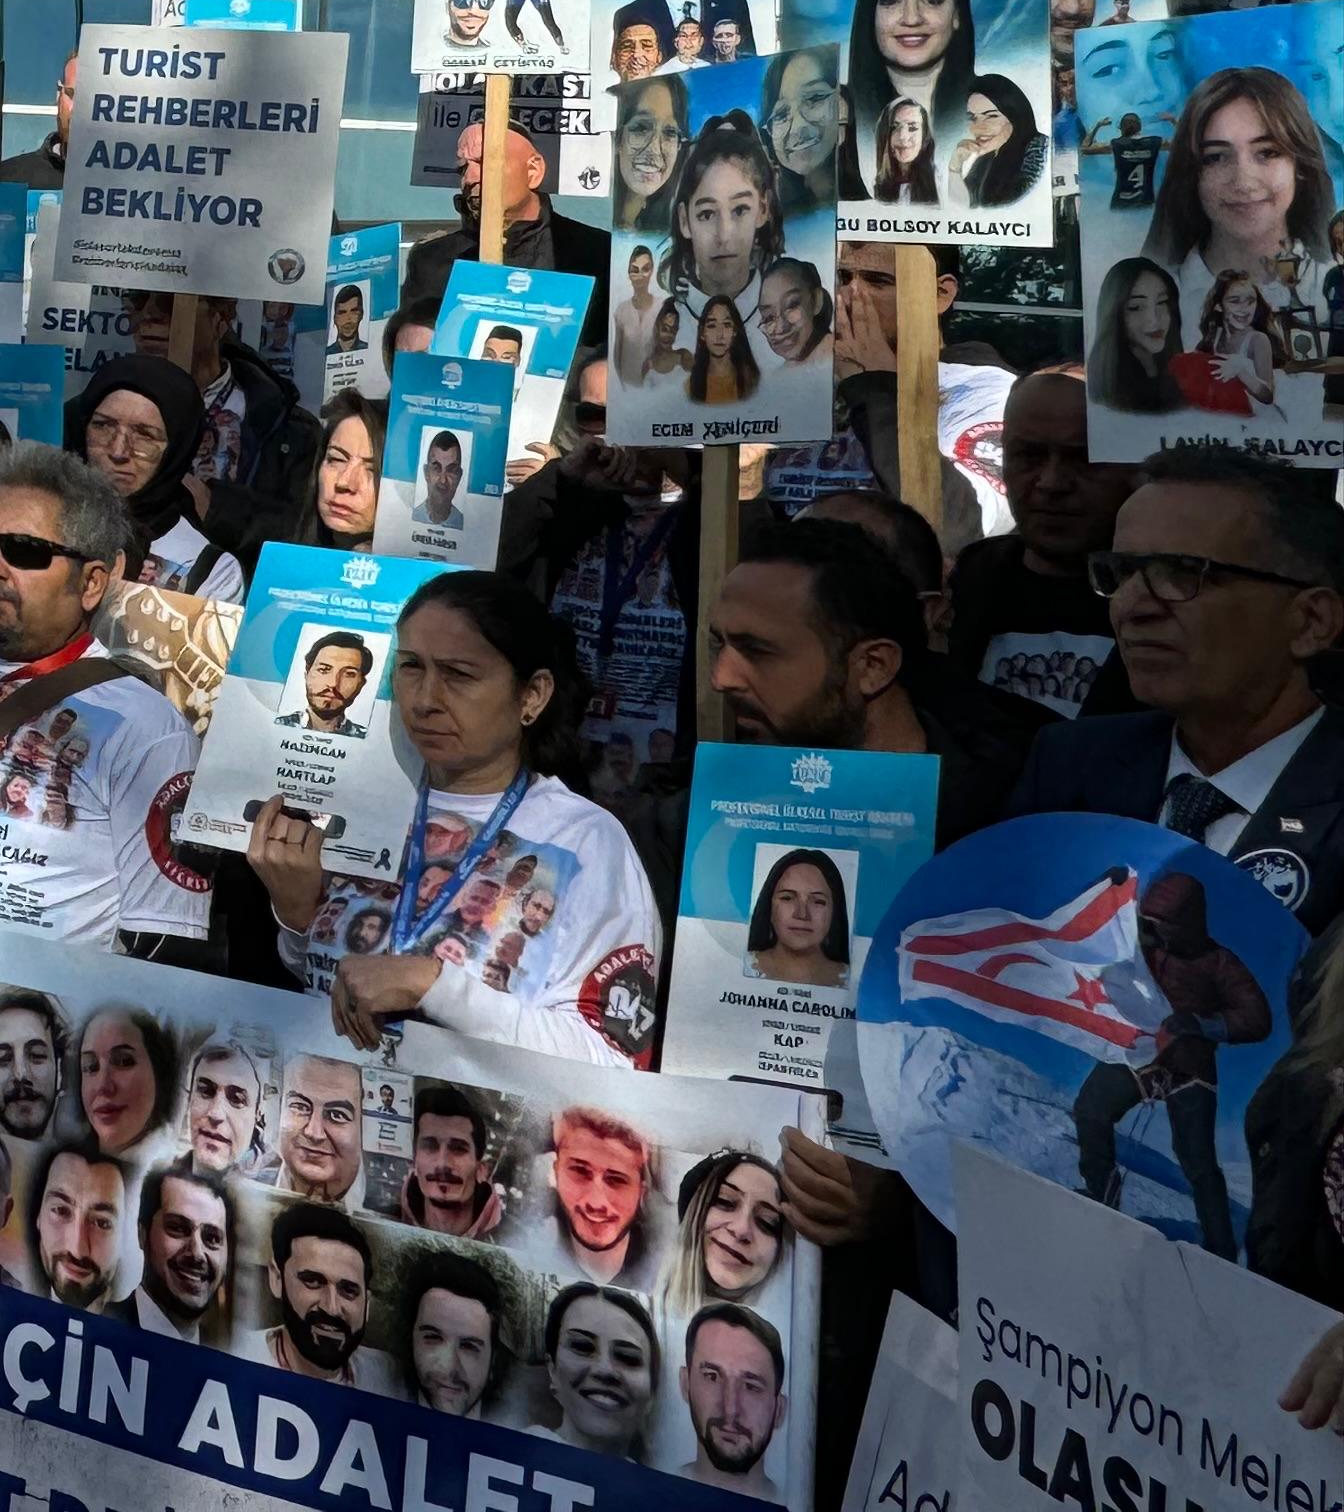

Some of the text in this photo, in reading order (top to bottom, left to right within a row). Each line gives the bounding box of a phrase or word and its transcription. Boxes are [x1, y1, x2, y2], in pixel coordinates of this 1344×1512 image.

[98, 44, 227, 81] TURİST
[91, 92, 320, 134] REHBERLERİ
[84, 139, 232, 178] ADALET
[1126, 163, 1145, 188] 4
[80, 185, 264, 229] BEKLİYOR
[946, 219, 1032, 238] KALAYCI
[1244, 433, 1344, 457] KALAYC
[975, 1296, 1344, 1512] Şampiyon Melek
